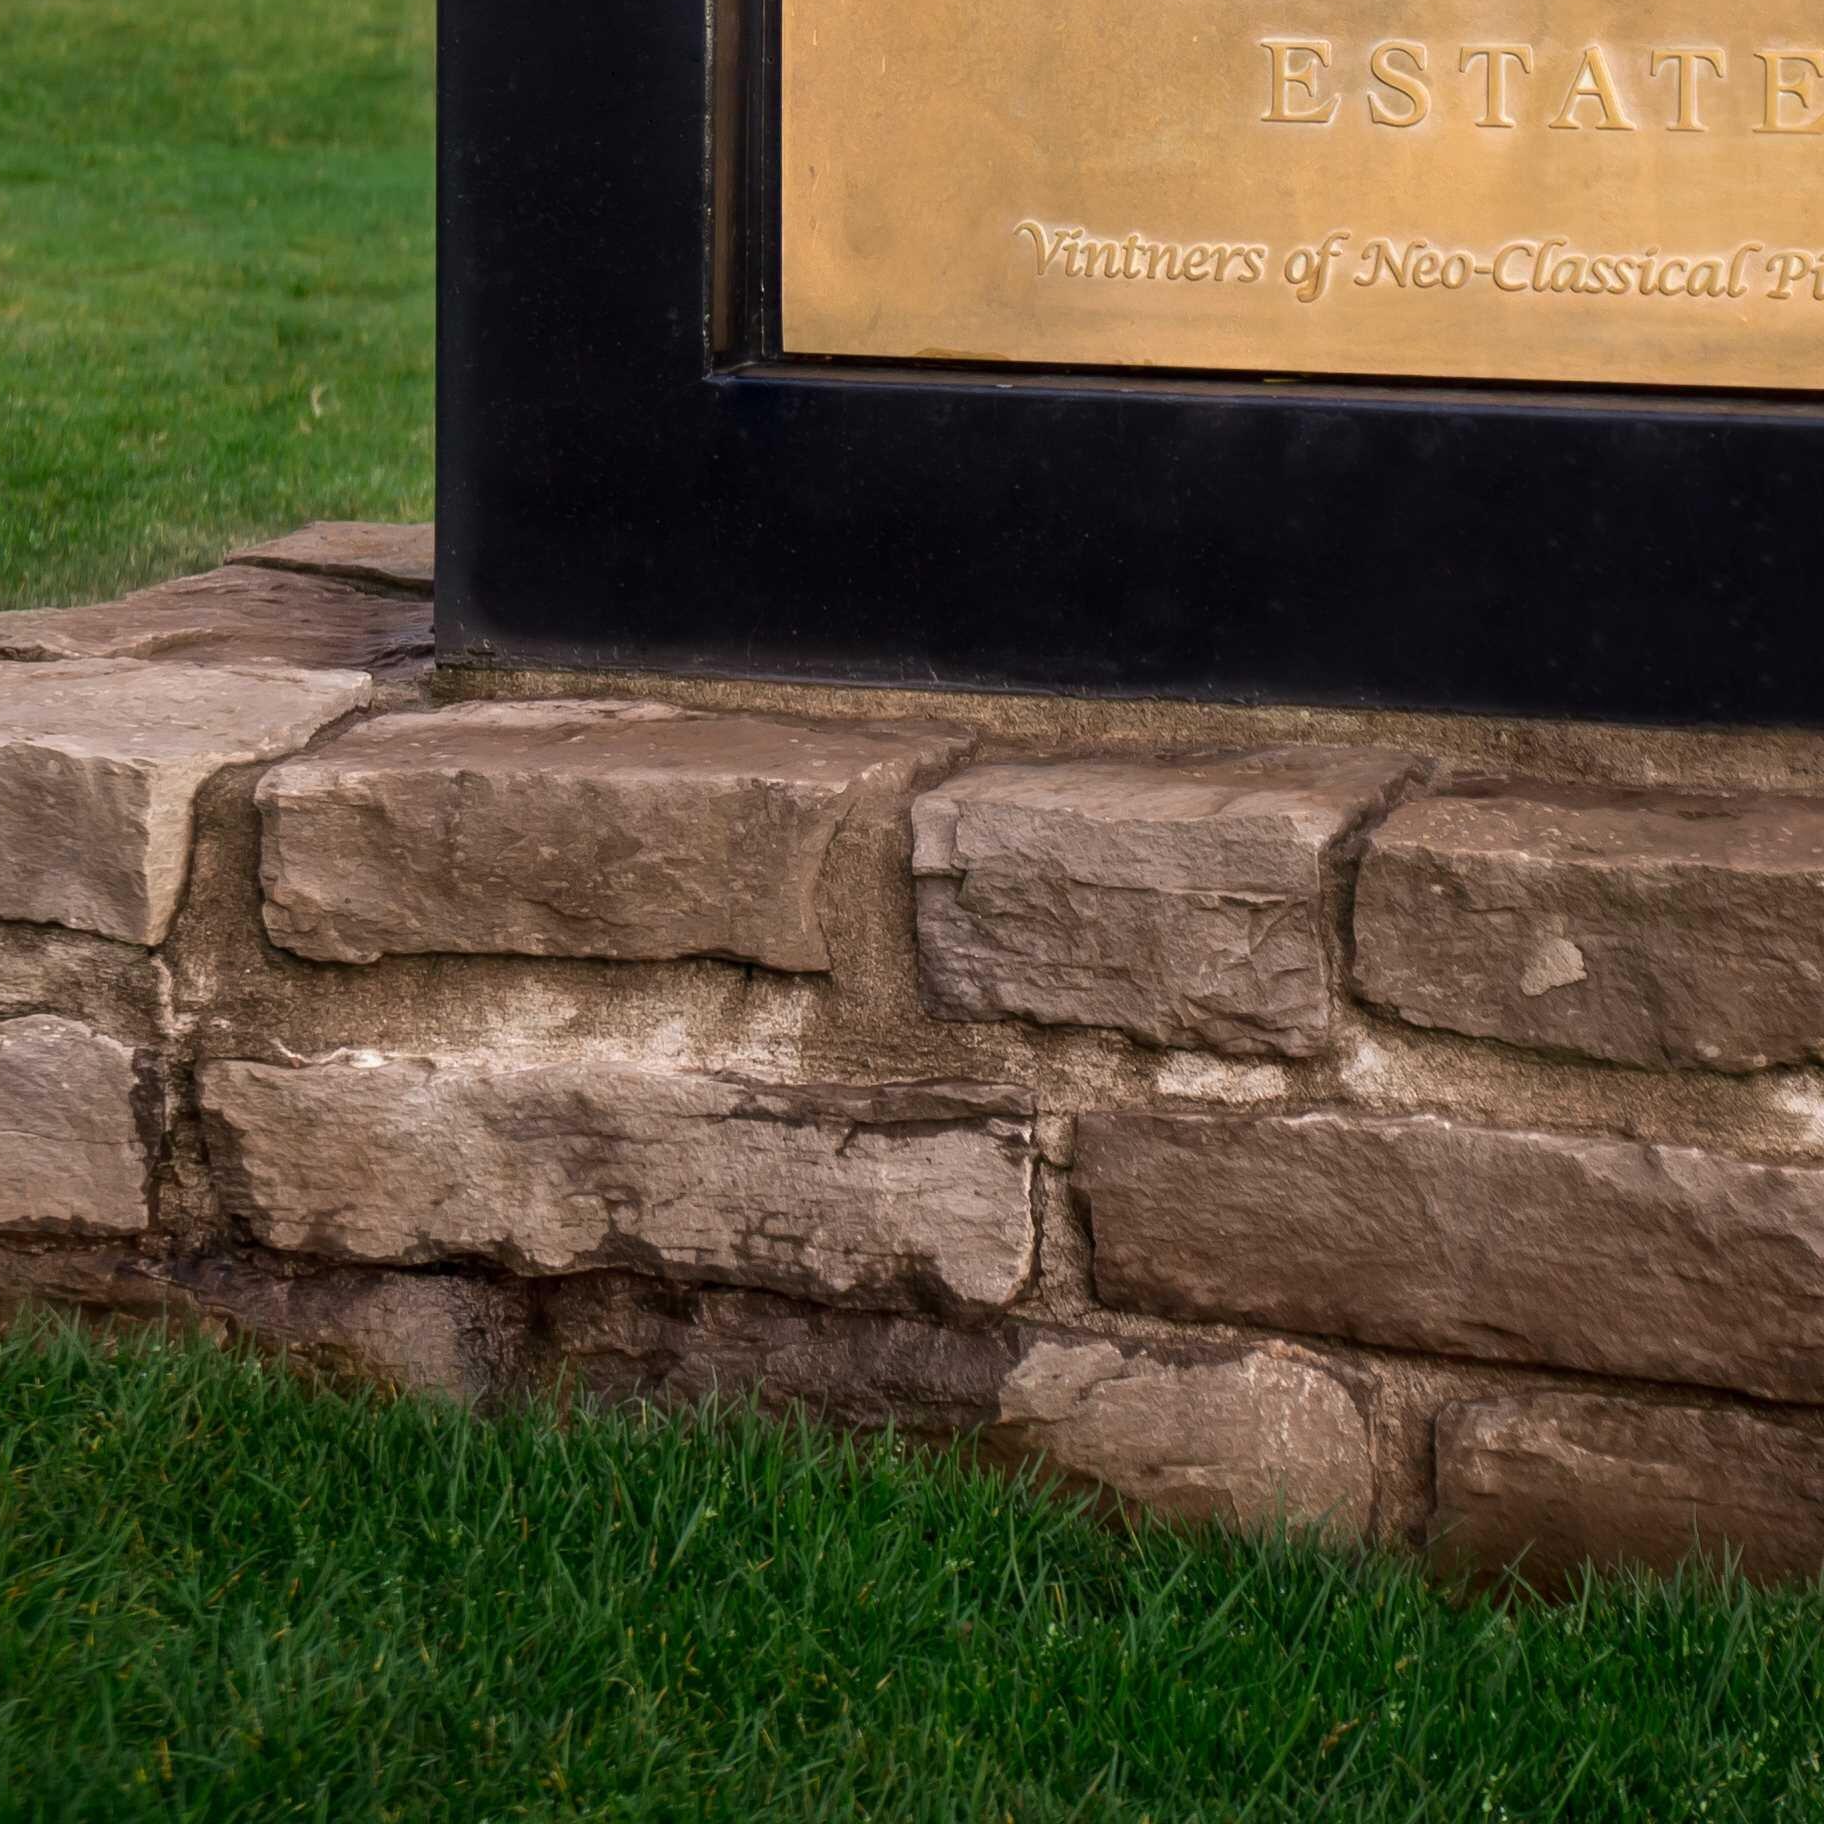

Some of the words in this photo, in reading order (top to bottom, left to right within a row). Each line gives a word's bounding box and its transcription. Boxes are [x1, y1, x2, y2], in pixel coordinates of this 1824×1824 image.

[1014, 220, 1265, 282] Vintners
[1283, 232, 1349, 302] of
[1353, 239, 1760, 298] Neo-Classical
